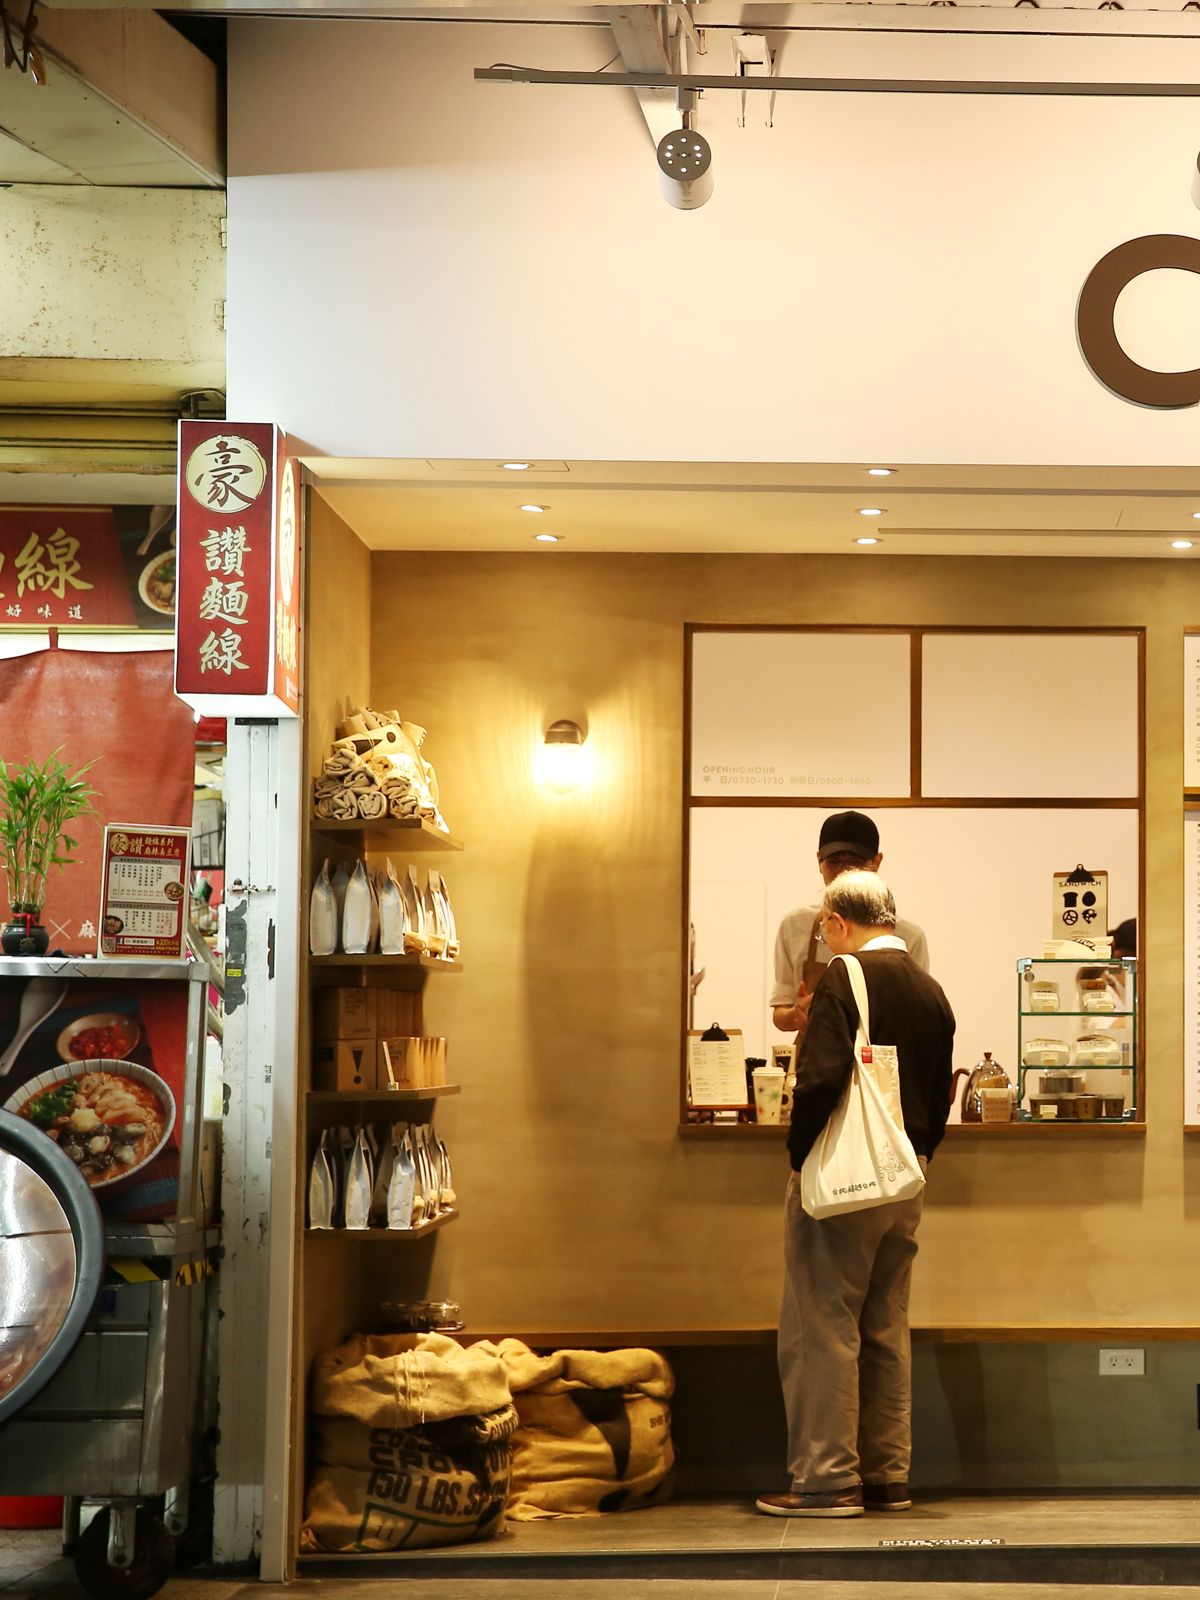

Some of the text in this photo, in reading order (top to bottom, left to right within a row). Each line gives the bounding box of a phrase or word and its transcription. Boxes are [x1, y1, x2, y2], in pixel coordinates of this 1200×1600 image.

[194, 440, 258, 508] 豪
[0, 528, 94, 599] 線
[5, 603, 84, 620] 好味道
[199, 526, 252, 677] 讚麵線
[702, 766, 775, 774] OPENING HOUR
[368, 1467, 412, 1504] 150
